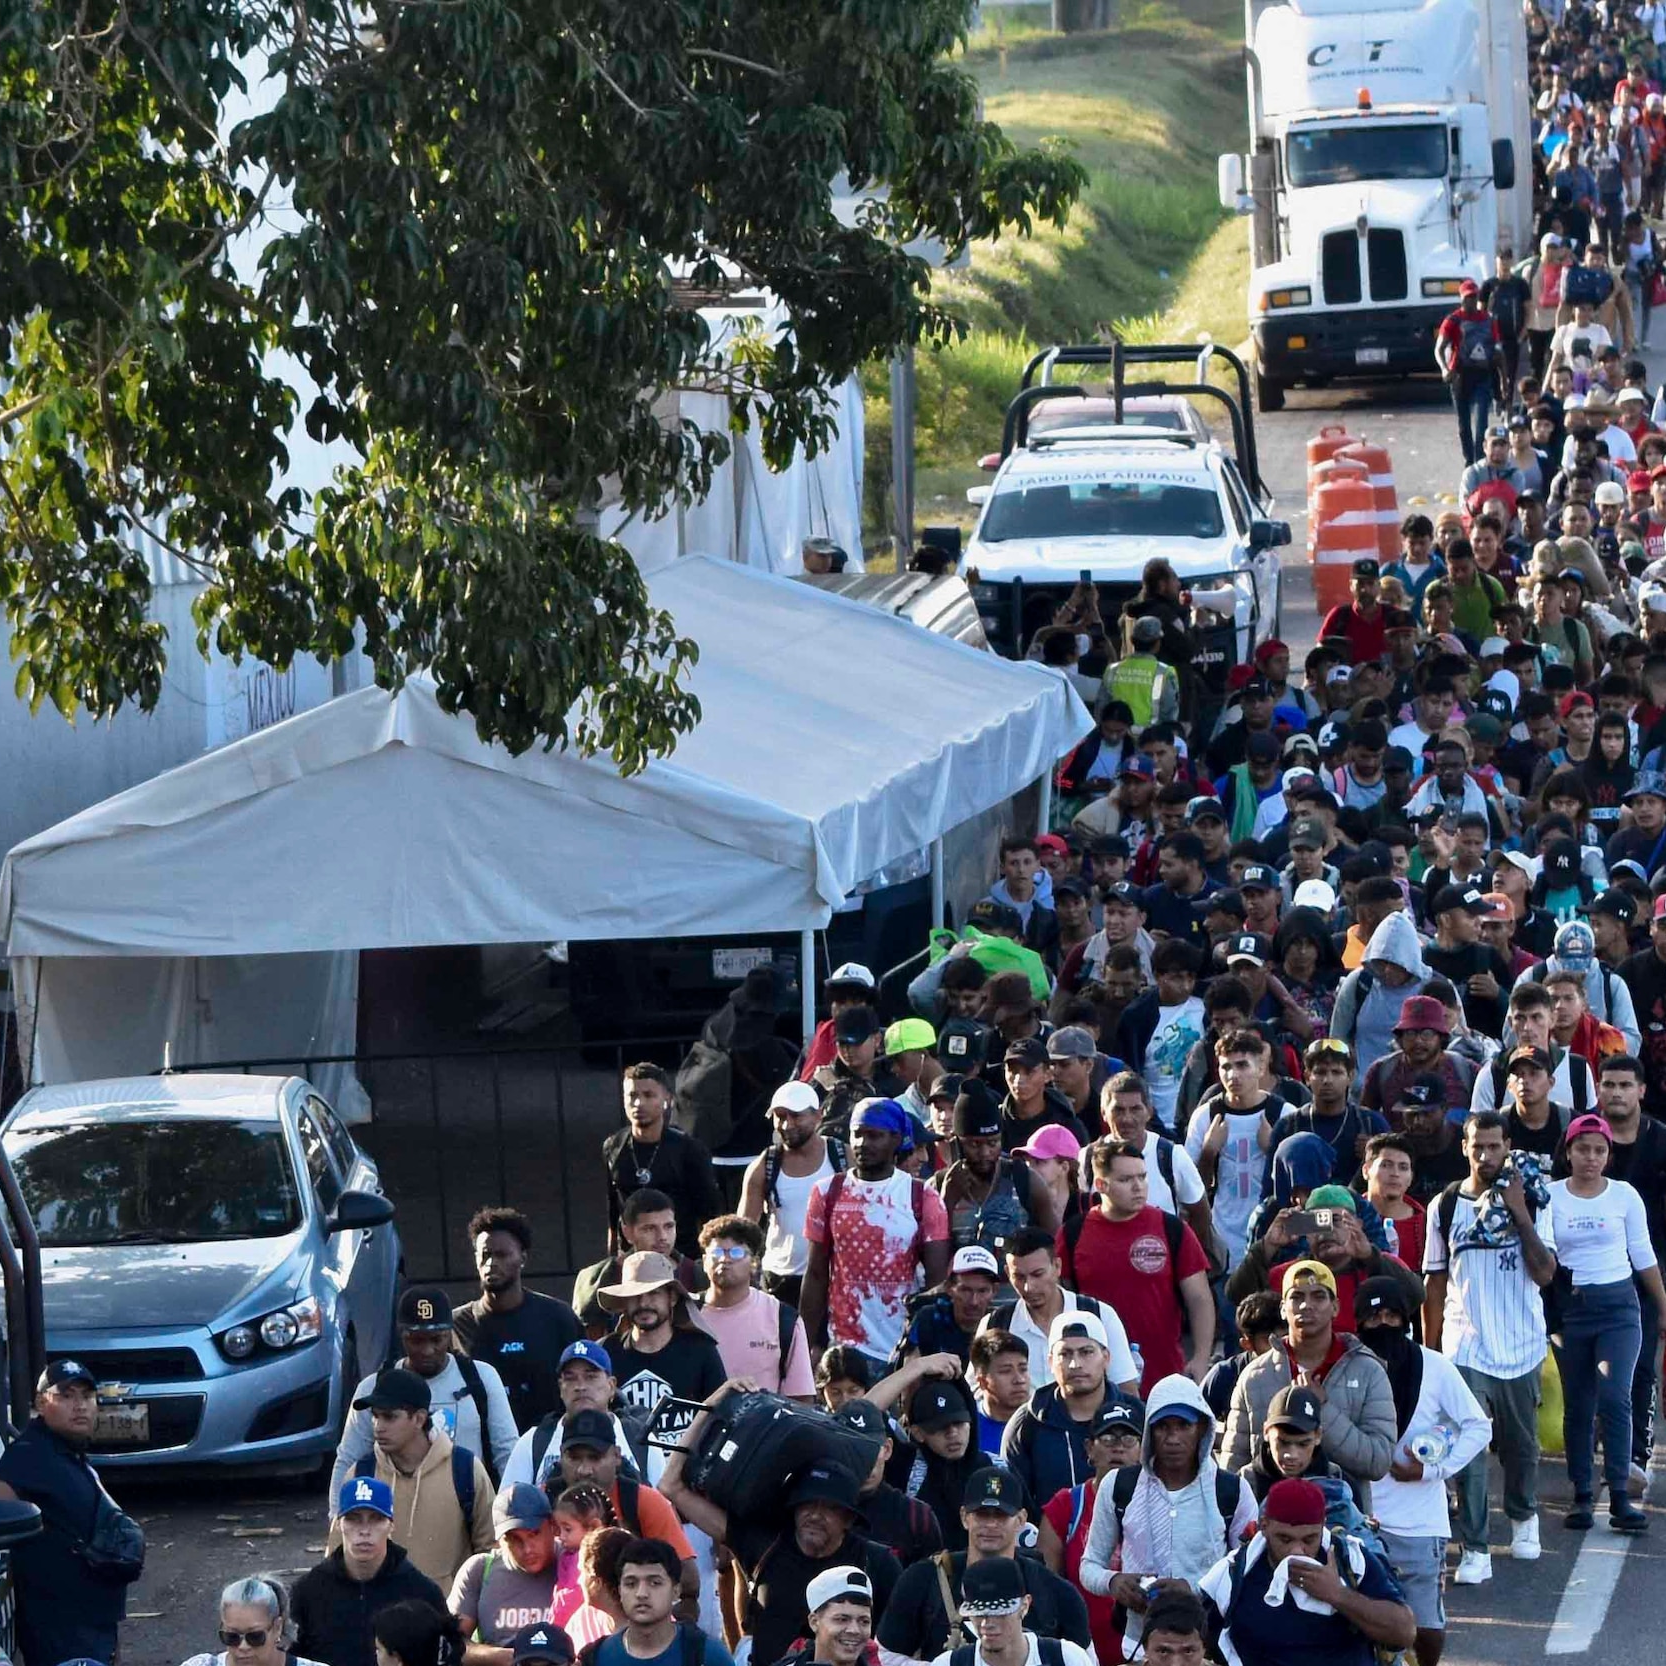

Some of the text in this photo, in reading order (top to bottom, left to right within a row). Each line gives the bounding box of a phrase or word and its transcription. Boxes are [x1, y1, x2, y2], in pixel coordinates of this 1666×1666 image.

[1307, 39, 1394, 67] C T
[495, 1607, 554, 1629] JORDA
